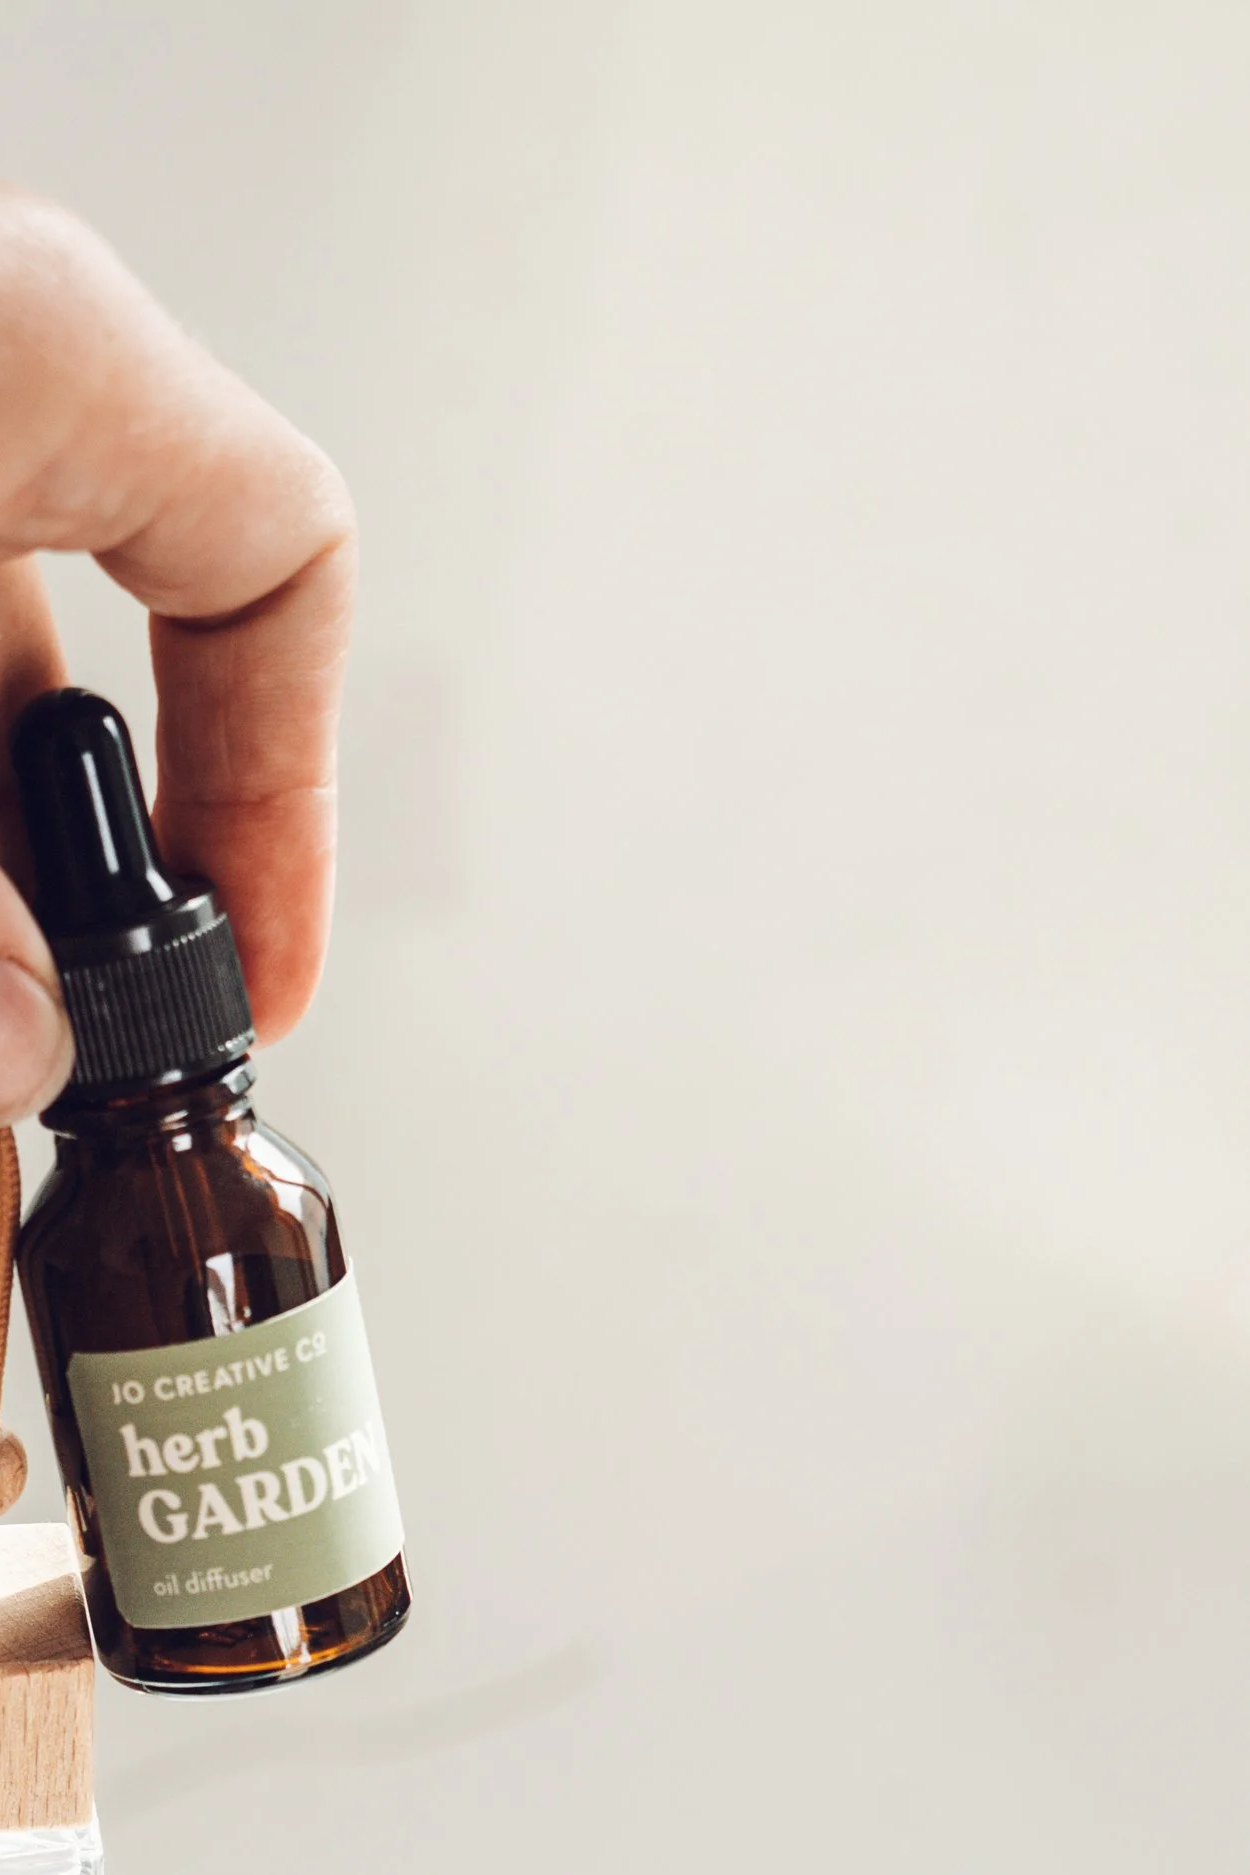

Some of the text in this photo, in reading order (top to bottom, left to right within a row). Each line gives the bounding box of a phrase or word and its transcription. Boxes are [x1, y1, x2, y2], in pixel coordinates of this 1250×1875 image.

[111, 1380, 145, 1405] JO
[153, 1347, 291, 1401] CREATIVE
[119, 1407, 269, 1478] herb
[138, 1419, 382, 1545] GARDEN
[153, 1562, 274, 1597] oil diffuser
